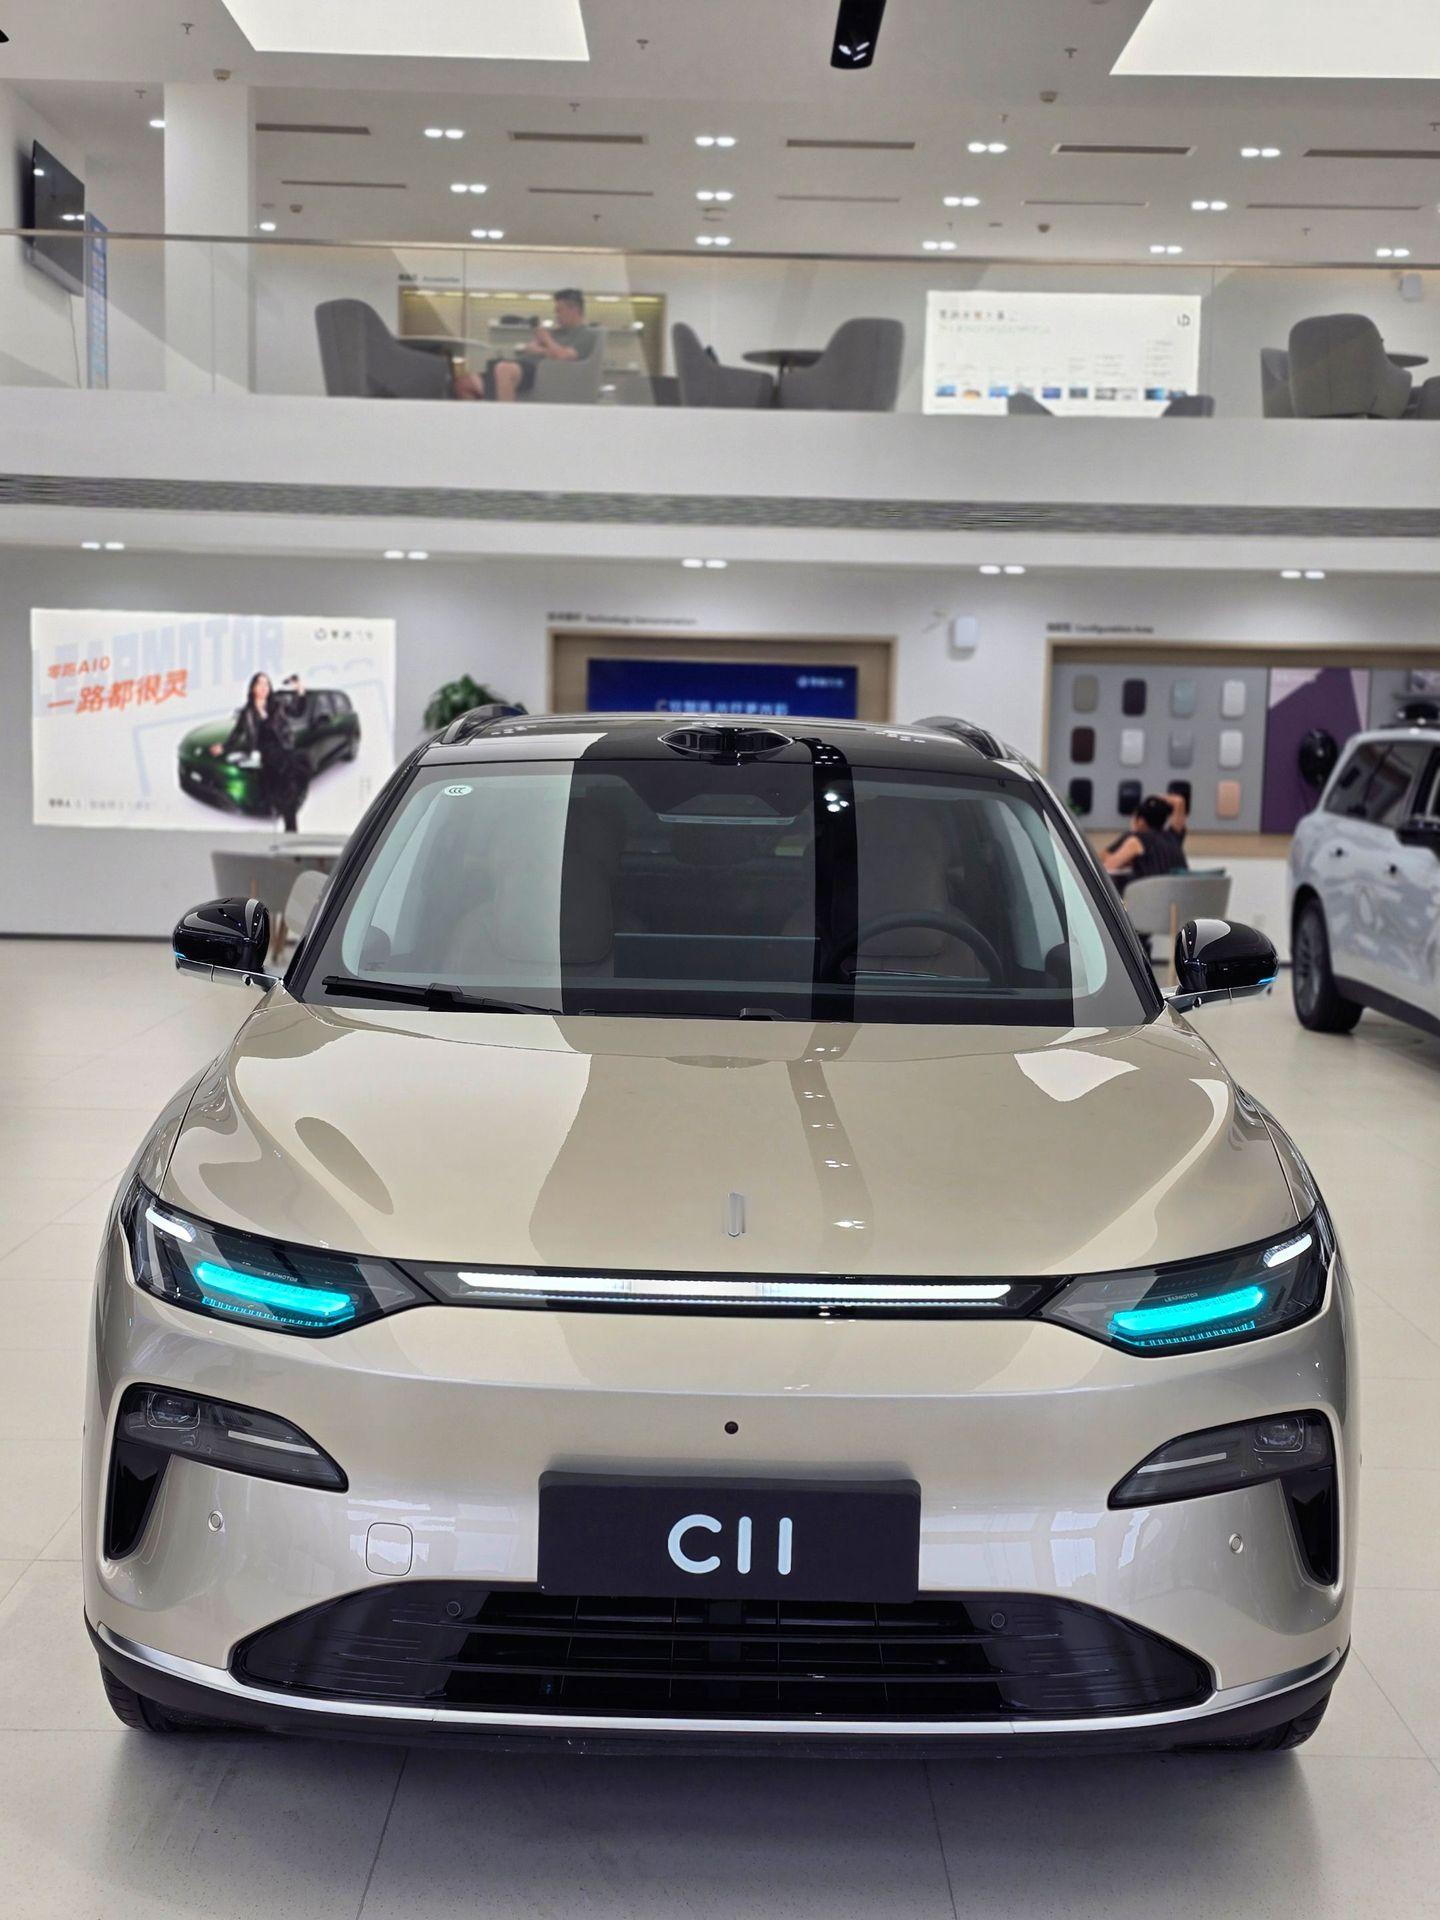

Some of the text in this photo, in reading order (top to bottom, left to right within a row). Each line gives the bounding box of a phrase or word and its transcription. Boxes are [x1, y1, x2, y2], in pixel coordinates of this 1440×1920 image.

[47, 668, 188, 714] 一路都很灵
